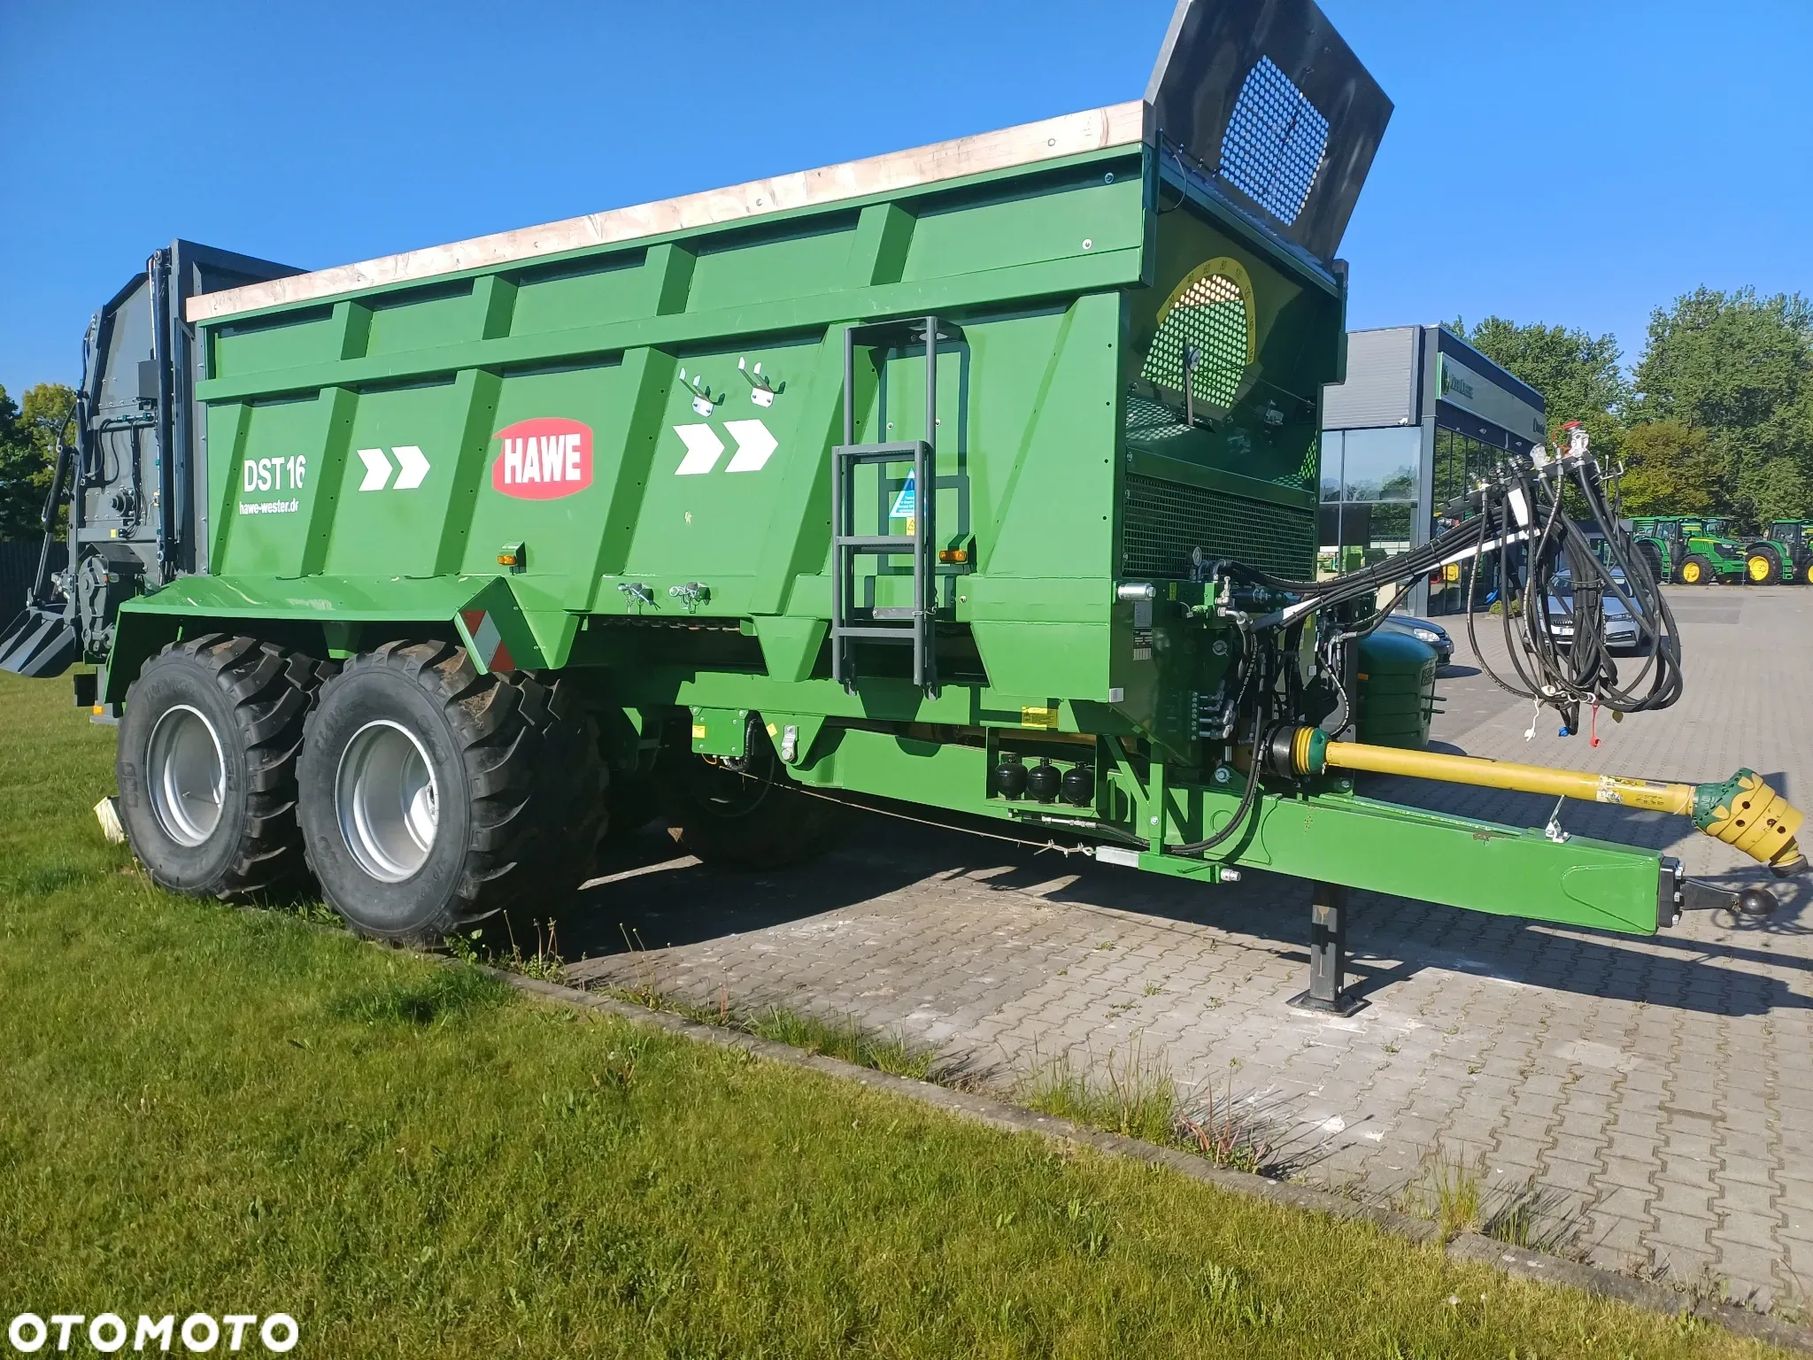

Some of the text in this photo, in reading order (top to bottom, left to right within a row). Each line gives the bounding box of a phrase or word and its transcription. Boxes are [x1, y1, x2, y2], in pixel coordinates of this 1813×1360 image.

[244, 454, 307, 492] DST 16
[504, 433, 581, 484] HAWE
